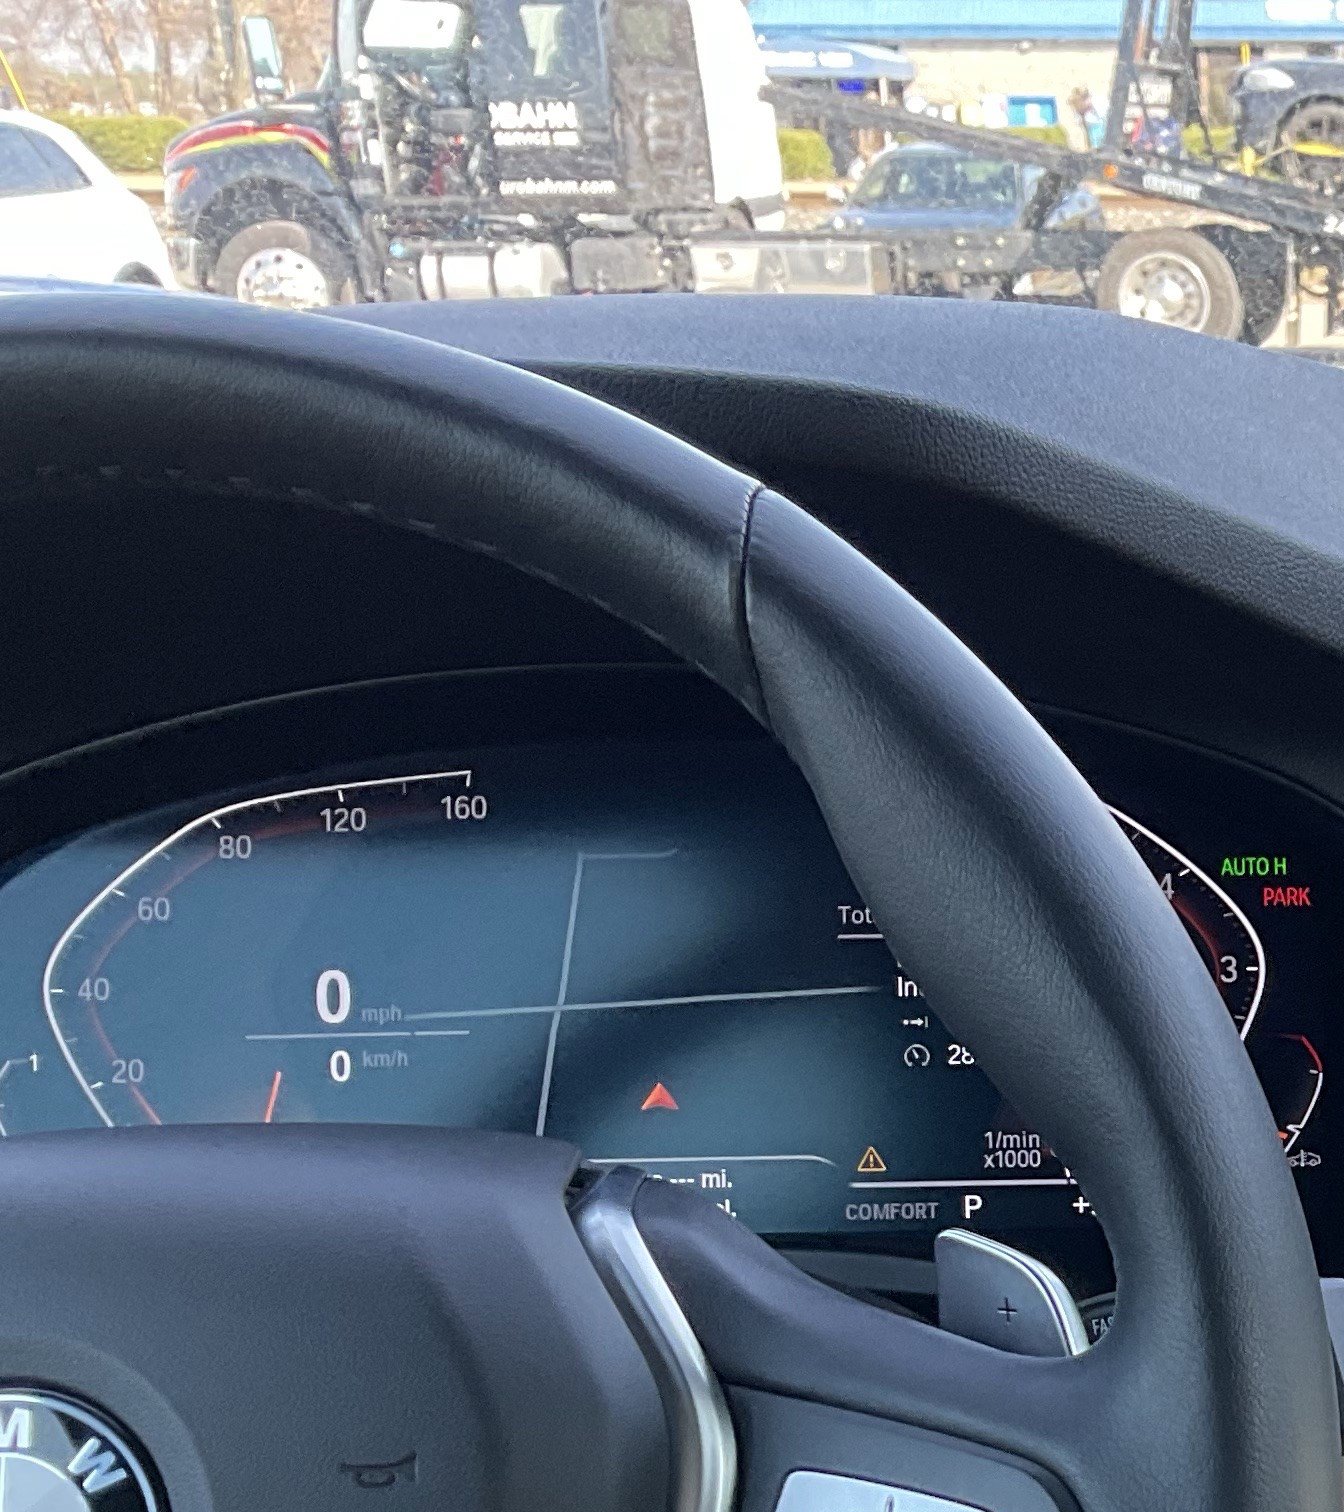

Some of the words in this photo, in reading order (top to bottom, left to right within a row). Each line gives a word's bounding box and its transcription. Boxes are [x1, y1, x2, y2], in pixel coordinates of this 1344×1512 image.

[320, 806, 367, 833] 120
[440, 794, 488, 821] 160
[218, 834, 253, 861] 80
[1221, 857, 1271, 876] AUTO
[1274, 857, 1288, 876] H
[1159, 872, 1175, 900] 4
[1262, 886, 1312, 907] PARK
[137, 896, 171, 923] 60
[1219, 954, 1239, 983] 3
[77, 977, 111, 1002] 40
[314, 968, 353, 1025] 0
[361, 1003, 402, 1025] mph
[110, 1058, 145, 1084] 20
[328, 1049, 353, 1082] 0
[362, 1048, 409, 1069] km/h
[983, 1129, 1041, 1150] 1/min
[983, 1148, 1042, 1169] x1000
[701, 1168, 734, 1190] mi.
[845, 1201, 939, 1221] COMFORT
[963, 1194, 983, 1219] P
